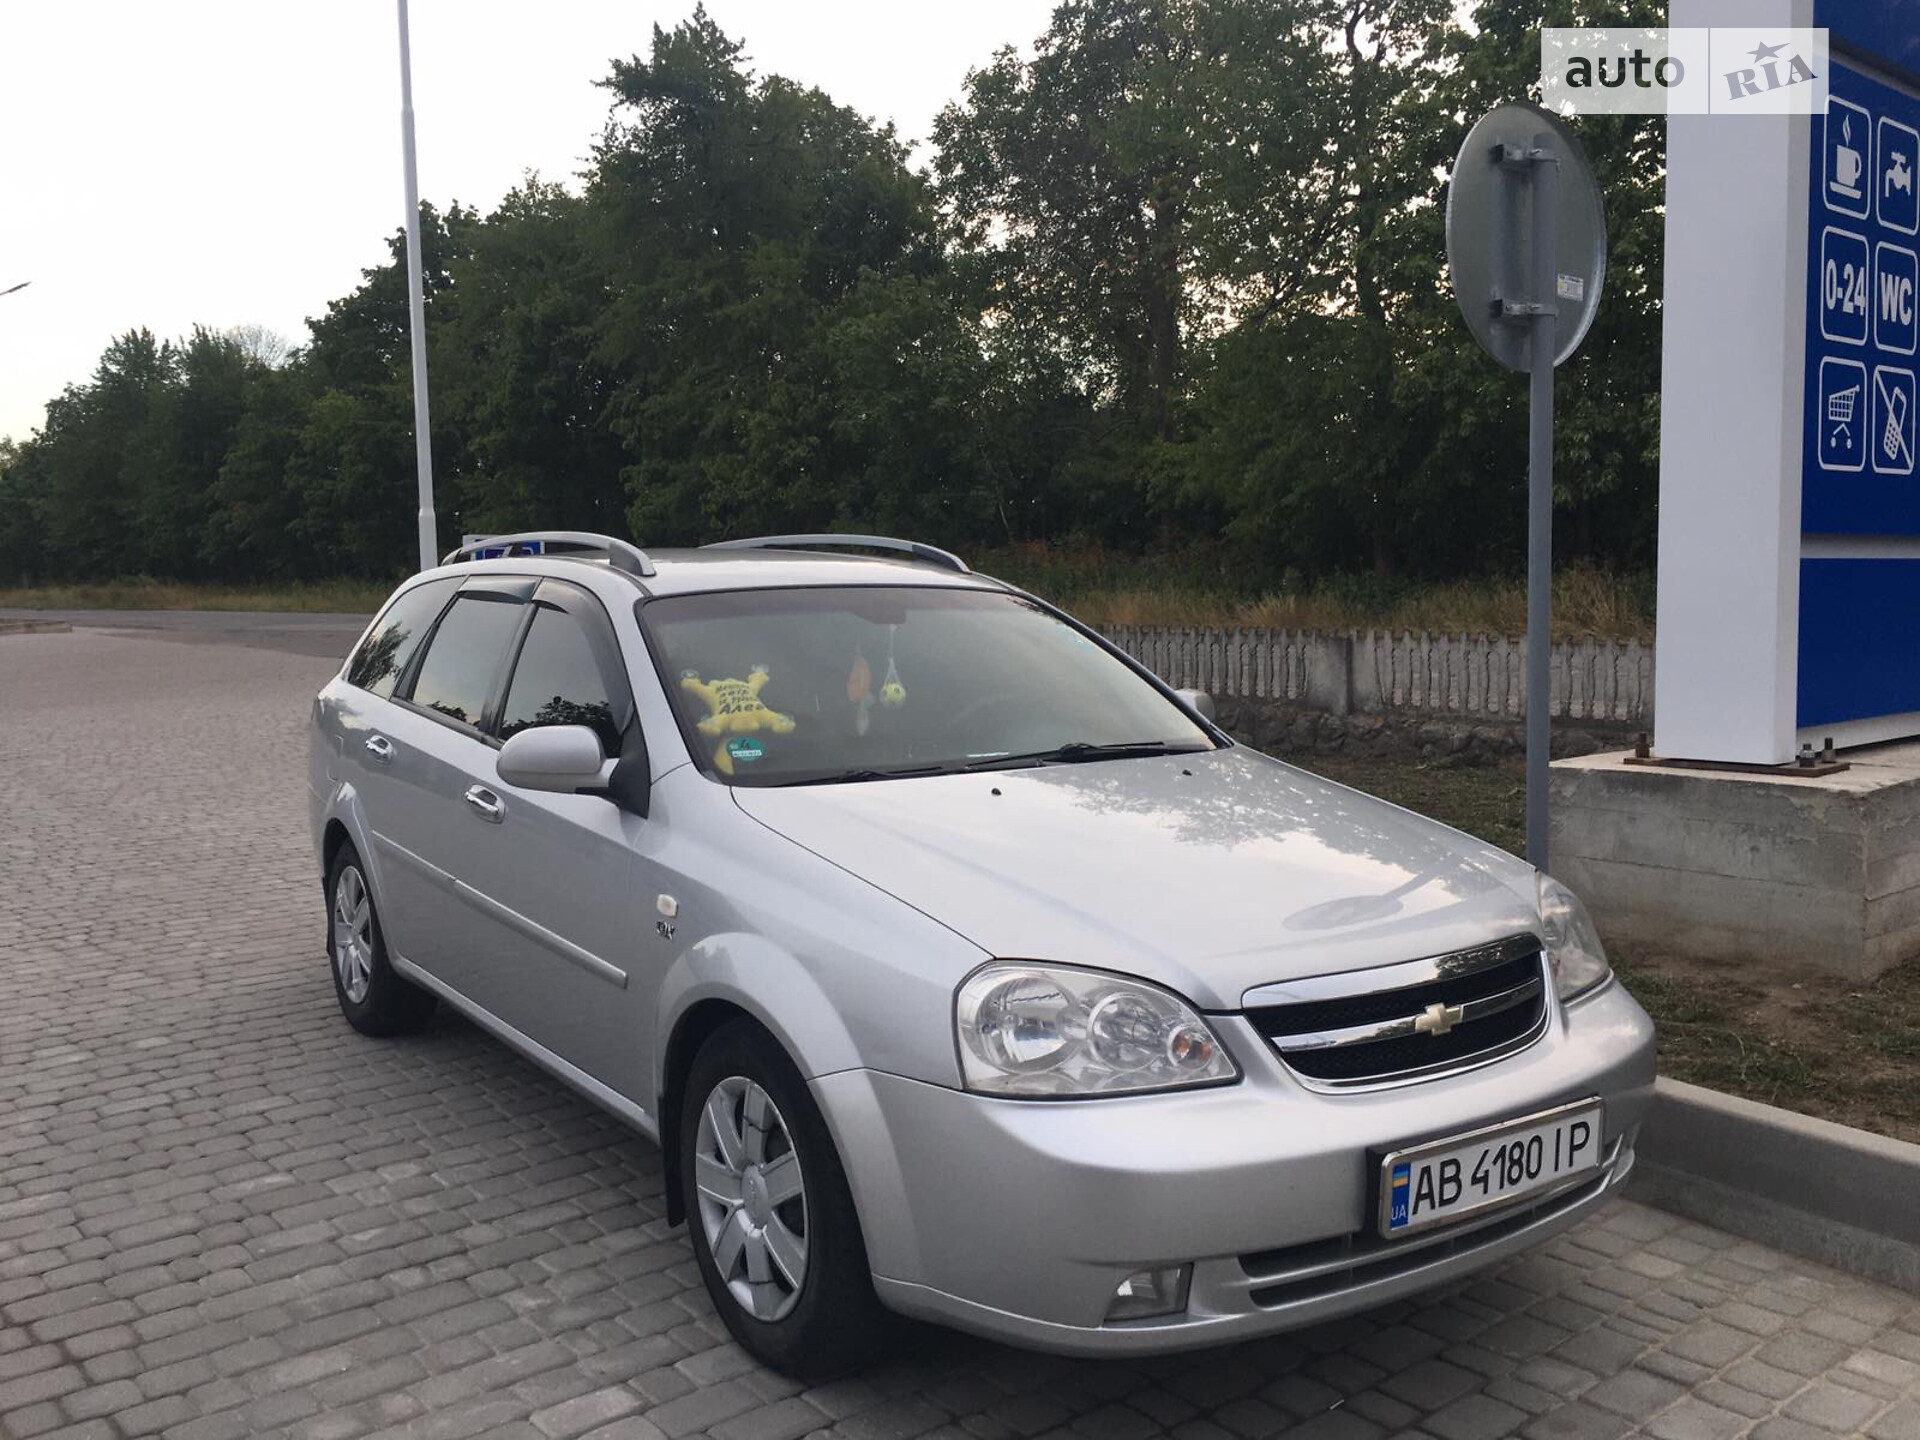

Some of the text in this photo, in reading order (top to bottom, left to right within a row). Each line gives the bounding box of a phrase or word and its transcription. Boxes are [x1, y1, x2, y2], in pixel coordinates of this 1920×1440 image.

[1825, 258, 1867, 316] 0-24
[1880, 272, 1913, 325] WC
[1412, 1121, 1590, 1215] AB 4180 IP
[1391, 1204, 1408, 1221] UA
